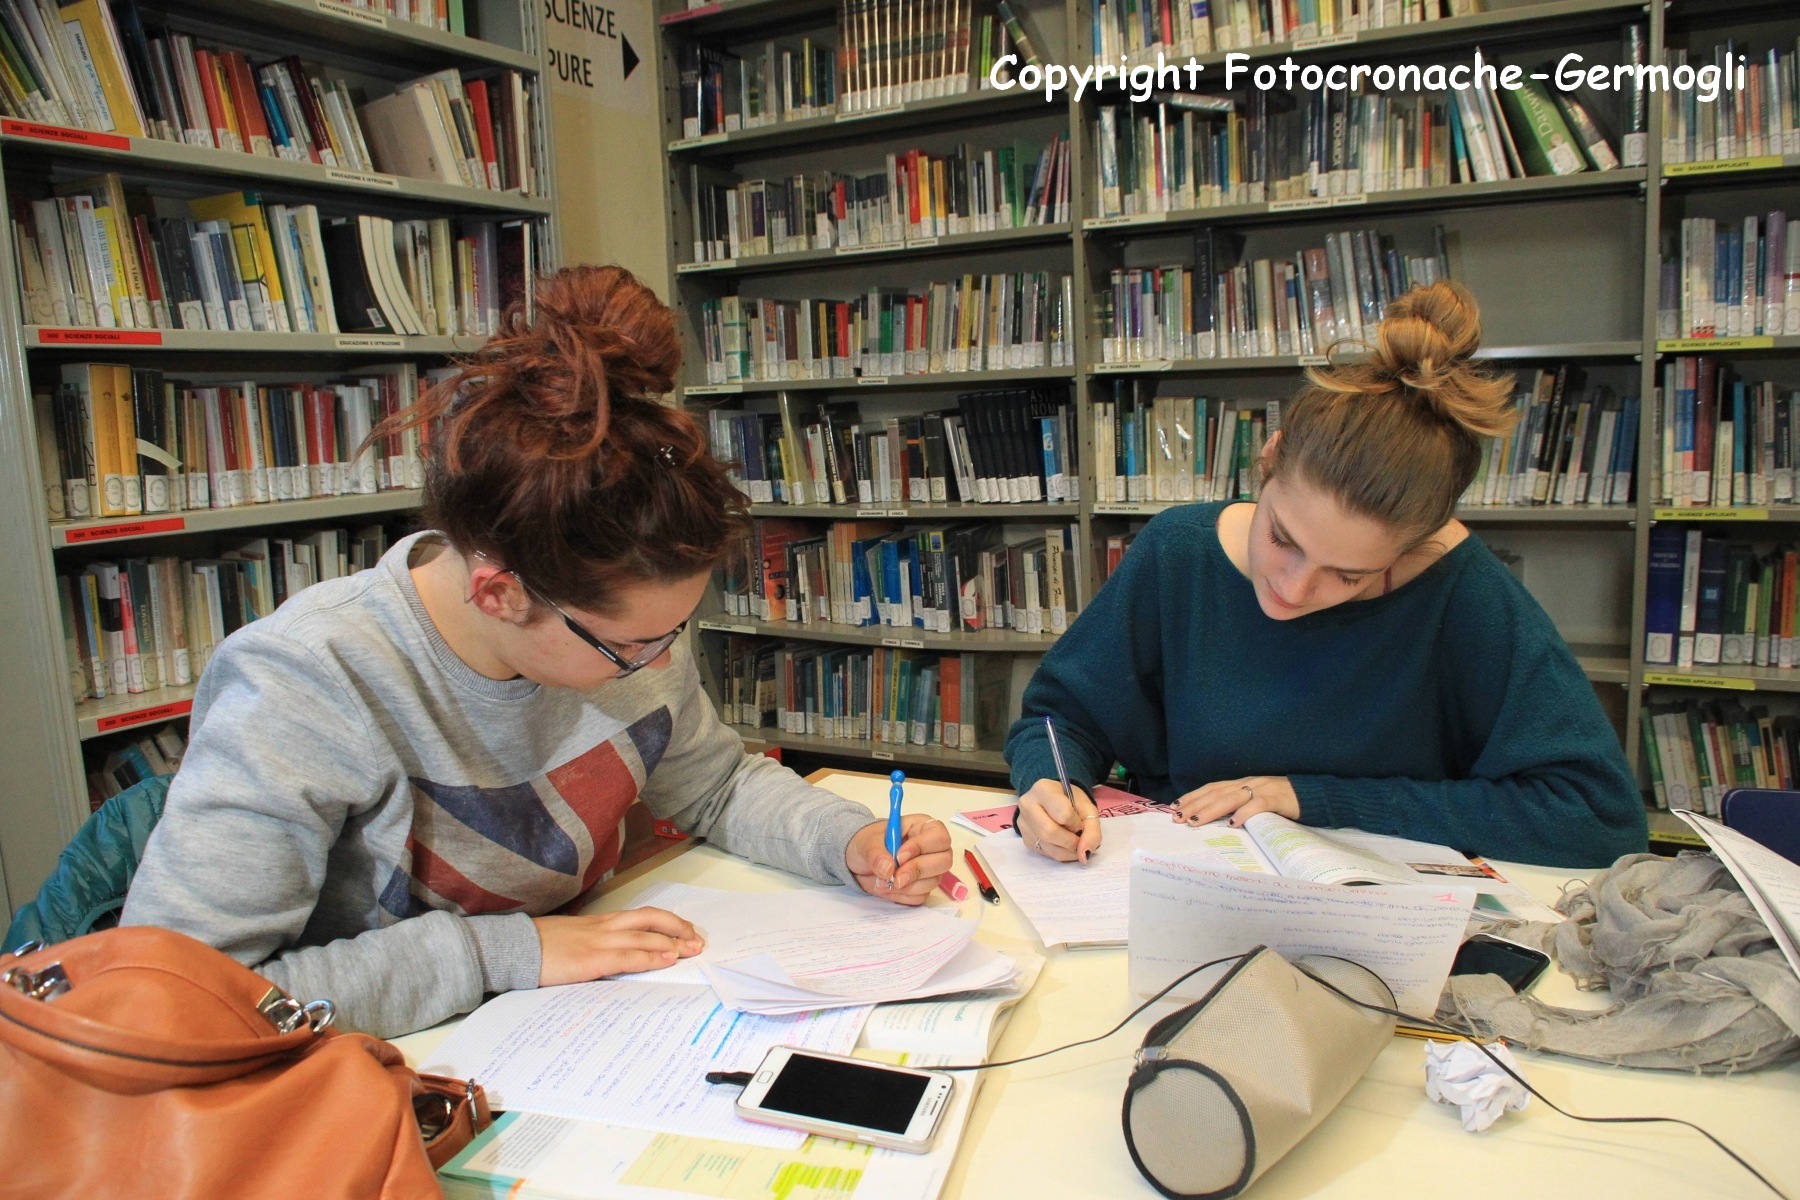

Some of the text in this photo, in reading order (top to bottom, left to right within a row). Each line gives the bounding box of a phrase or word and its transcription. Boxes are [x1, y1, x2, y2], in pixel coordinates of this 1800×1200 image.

[29, 126, 58, 137] SCIENZE
[60, 131, 88, 140] SOCIALI
[90, 528, 118, 537] SCIENZE
[119, 525, 145, 533] SOCIALI
[1051, 545, 1060, 576] Principi
[121, 713, 147, 722] SCIENZE
[149, 707, 173, 716] SOCIALI
